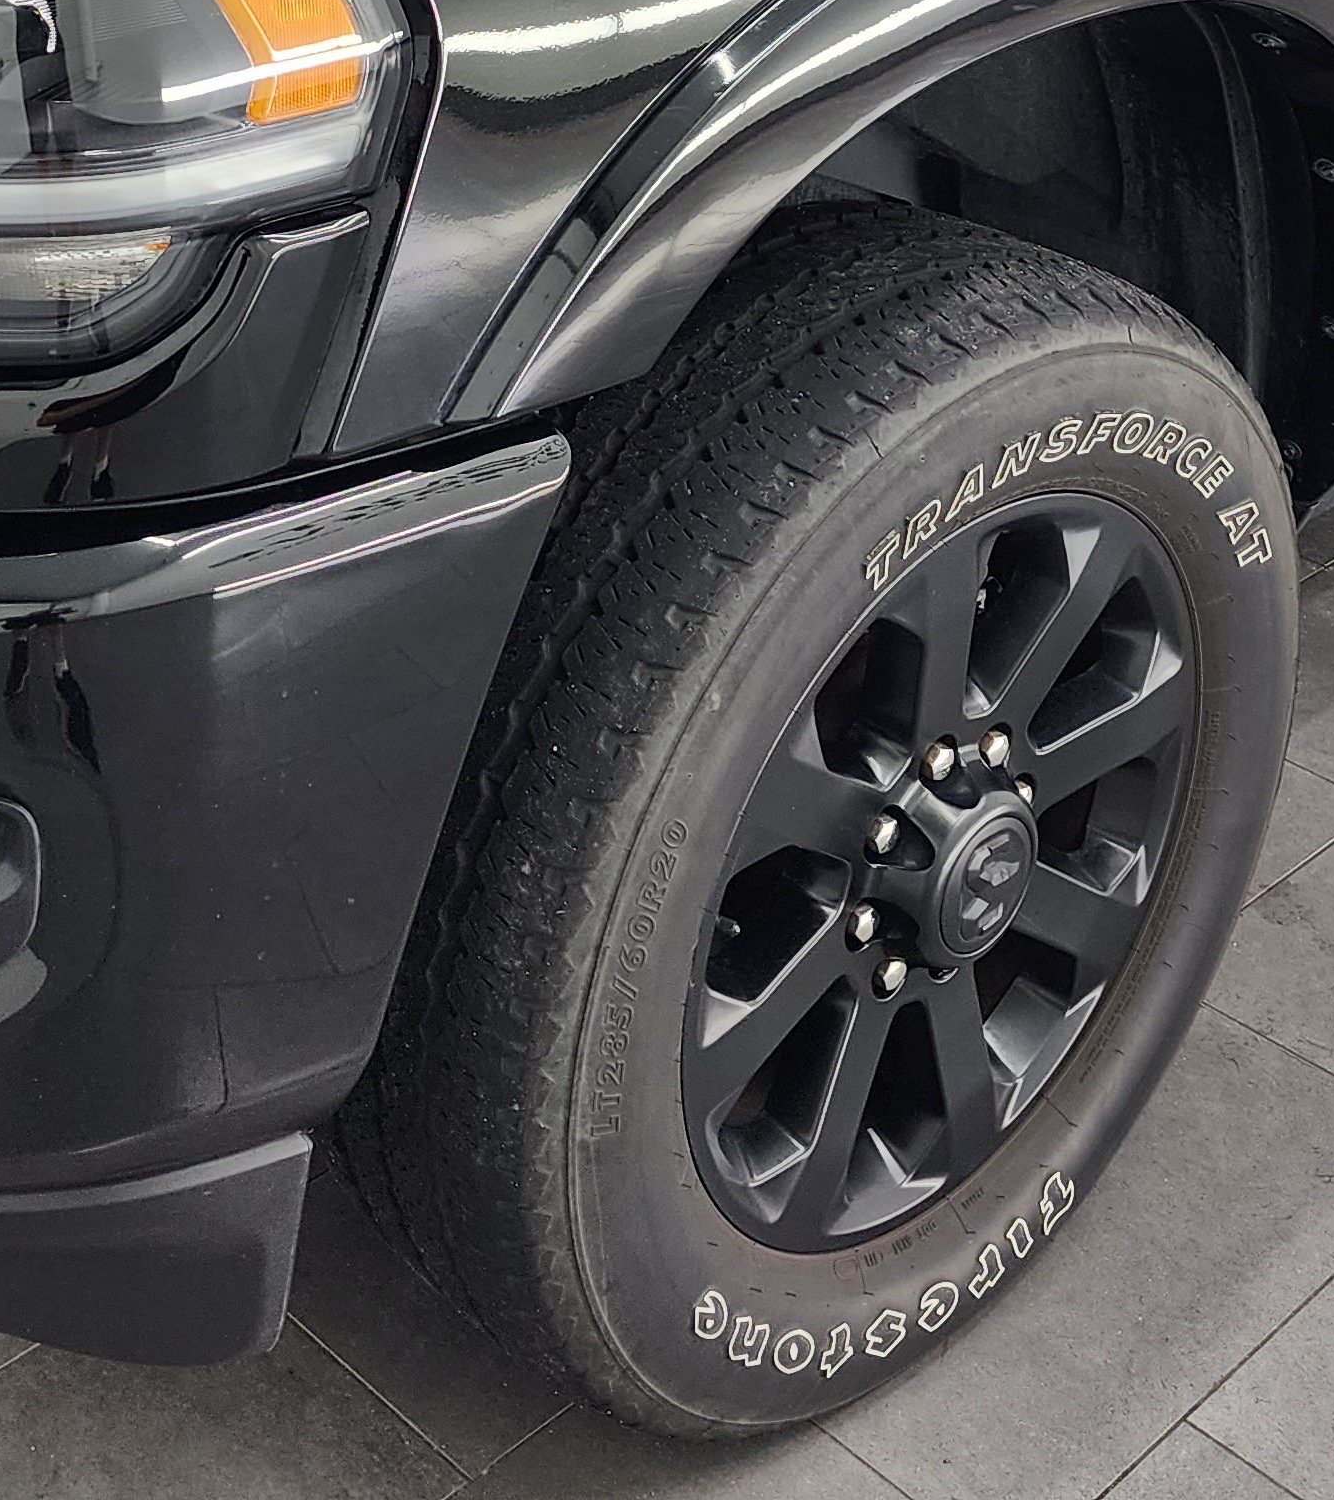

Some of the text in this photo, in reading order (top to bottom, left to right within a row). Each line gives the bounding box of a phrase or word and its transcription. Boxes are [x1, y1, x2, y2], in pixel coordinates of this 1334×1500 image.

[862, 408, 1274, 592] TRANSFORCE AT
[589, 818, 689, 1139] LT285/60R20
[693, 1171, 1075, 1379] Firestone
